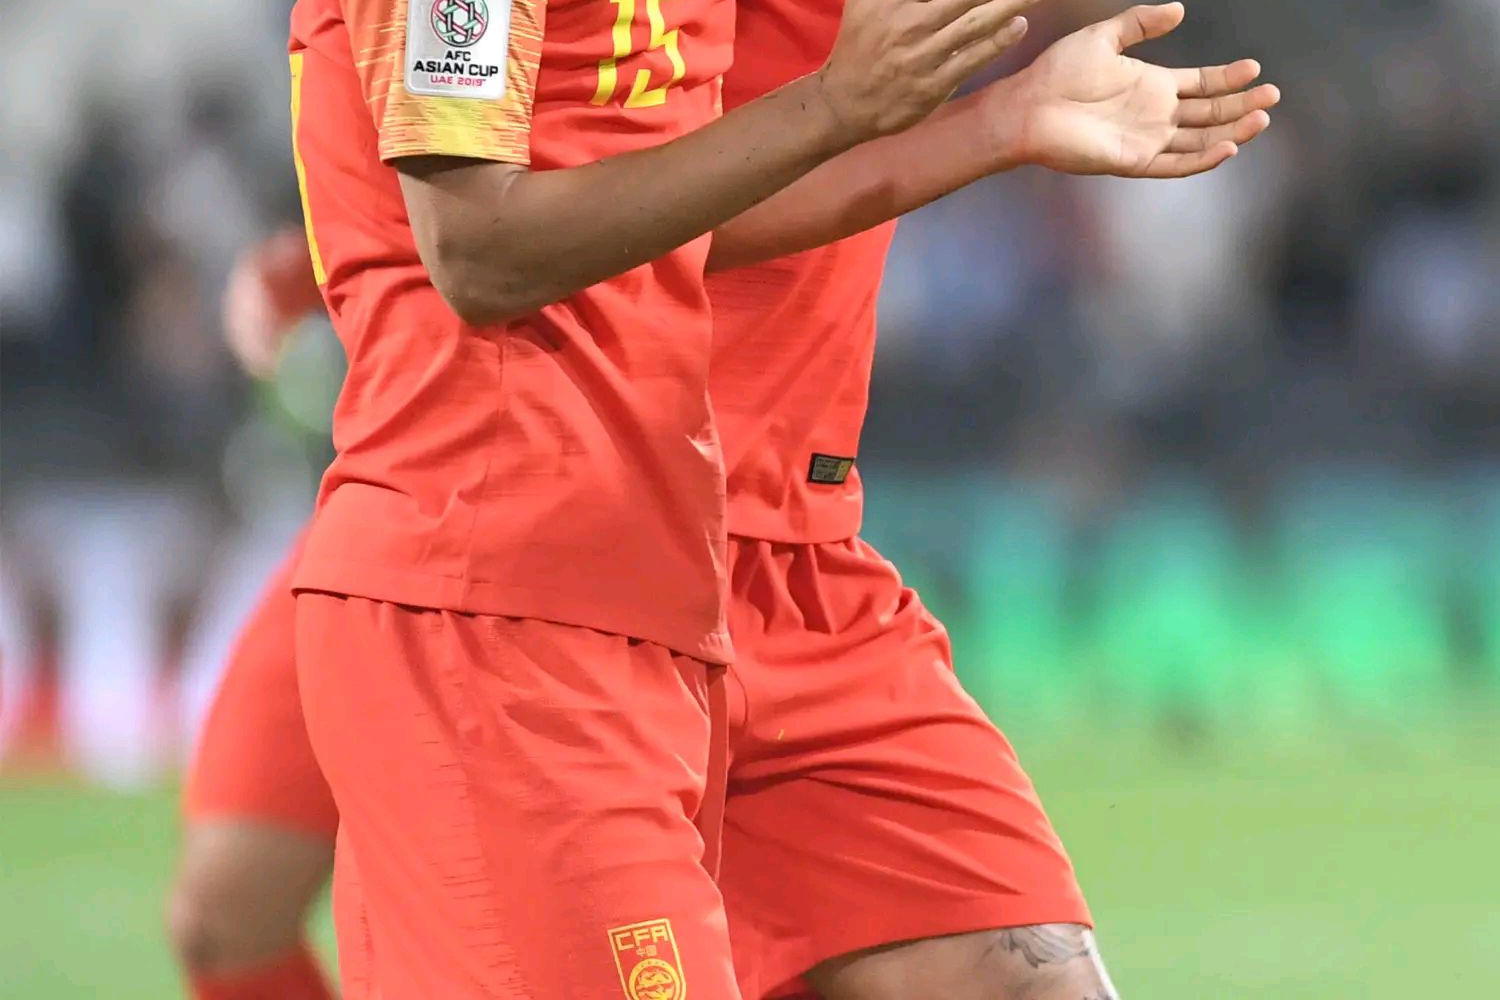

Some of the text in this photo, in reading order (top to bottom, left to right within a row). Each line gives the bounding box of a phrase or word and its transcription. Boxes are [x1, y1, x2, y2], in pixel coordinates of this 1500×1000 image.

[445, 50, 471, 62] AFC
[413, 60, 499, 77] ASIAN CUP
[430, 75, 453, 85] UAE
[615, 925, 669, 951] CFA
